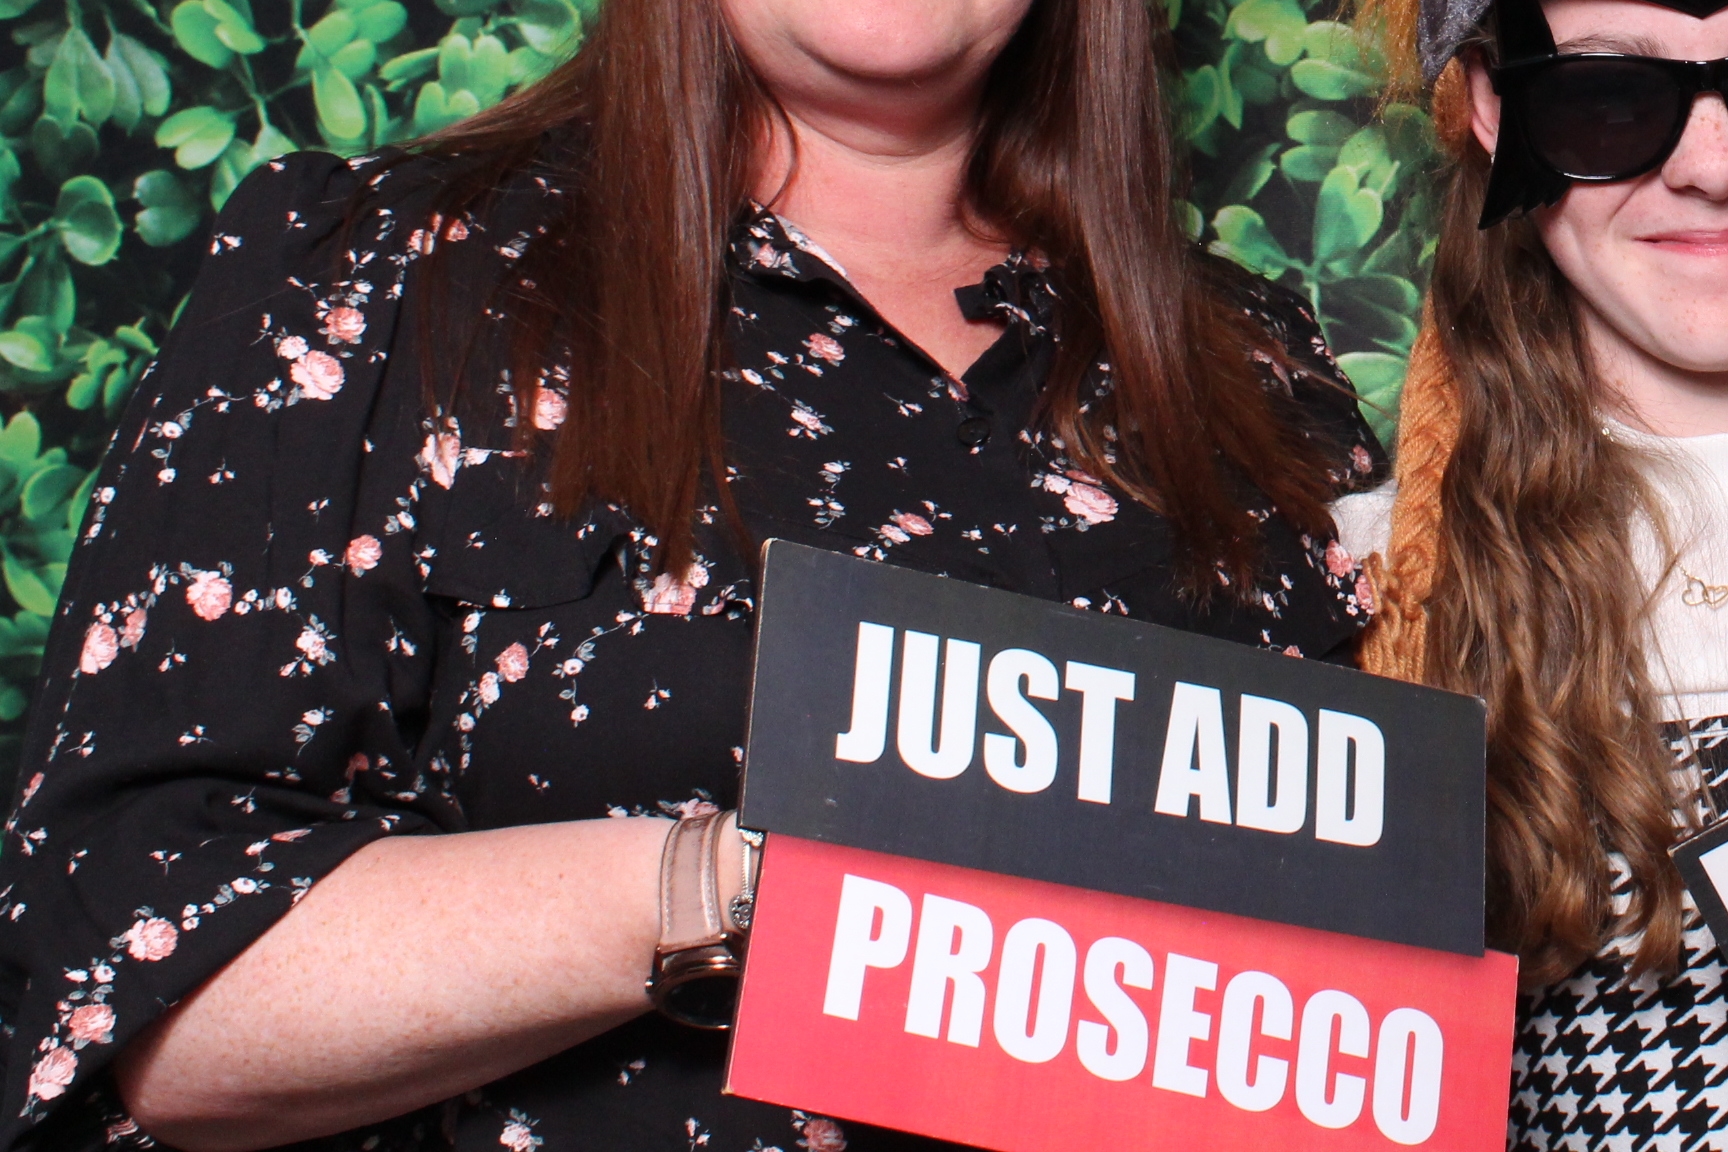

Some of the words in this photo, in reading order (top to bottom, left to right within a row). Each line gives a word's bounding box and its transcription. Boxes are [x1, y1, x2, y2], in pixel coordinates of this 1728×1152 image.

[835, 621, 1135, 794] JUST
[1155, 682, 1385, 847] ADD
[823, 874, 1443, 1146] PROSECCO
